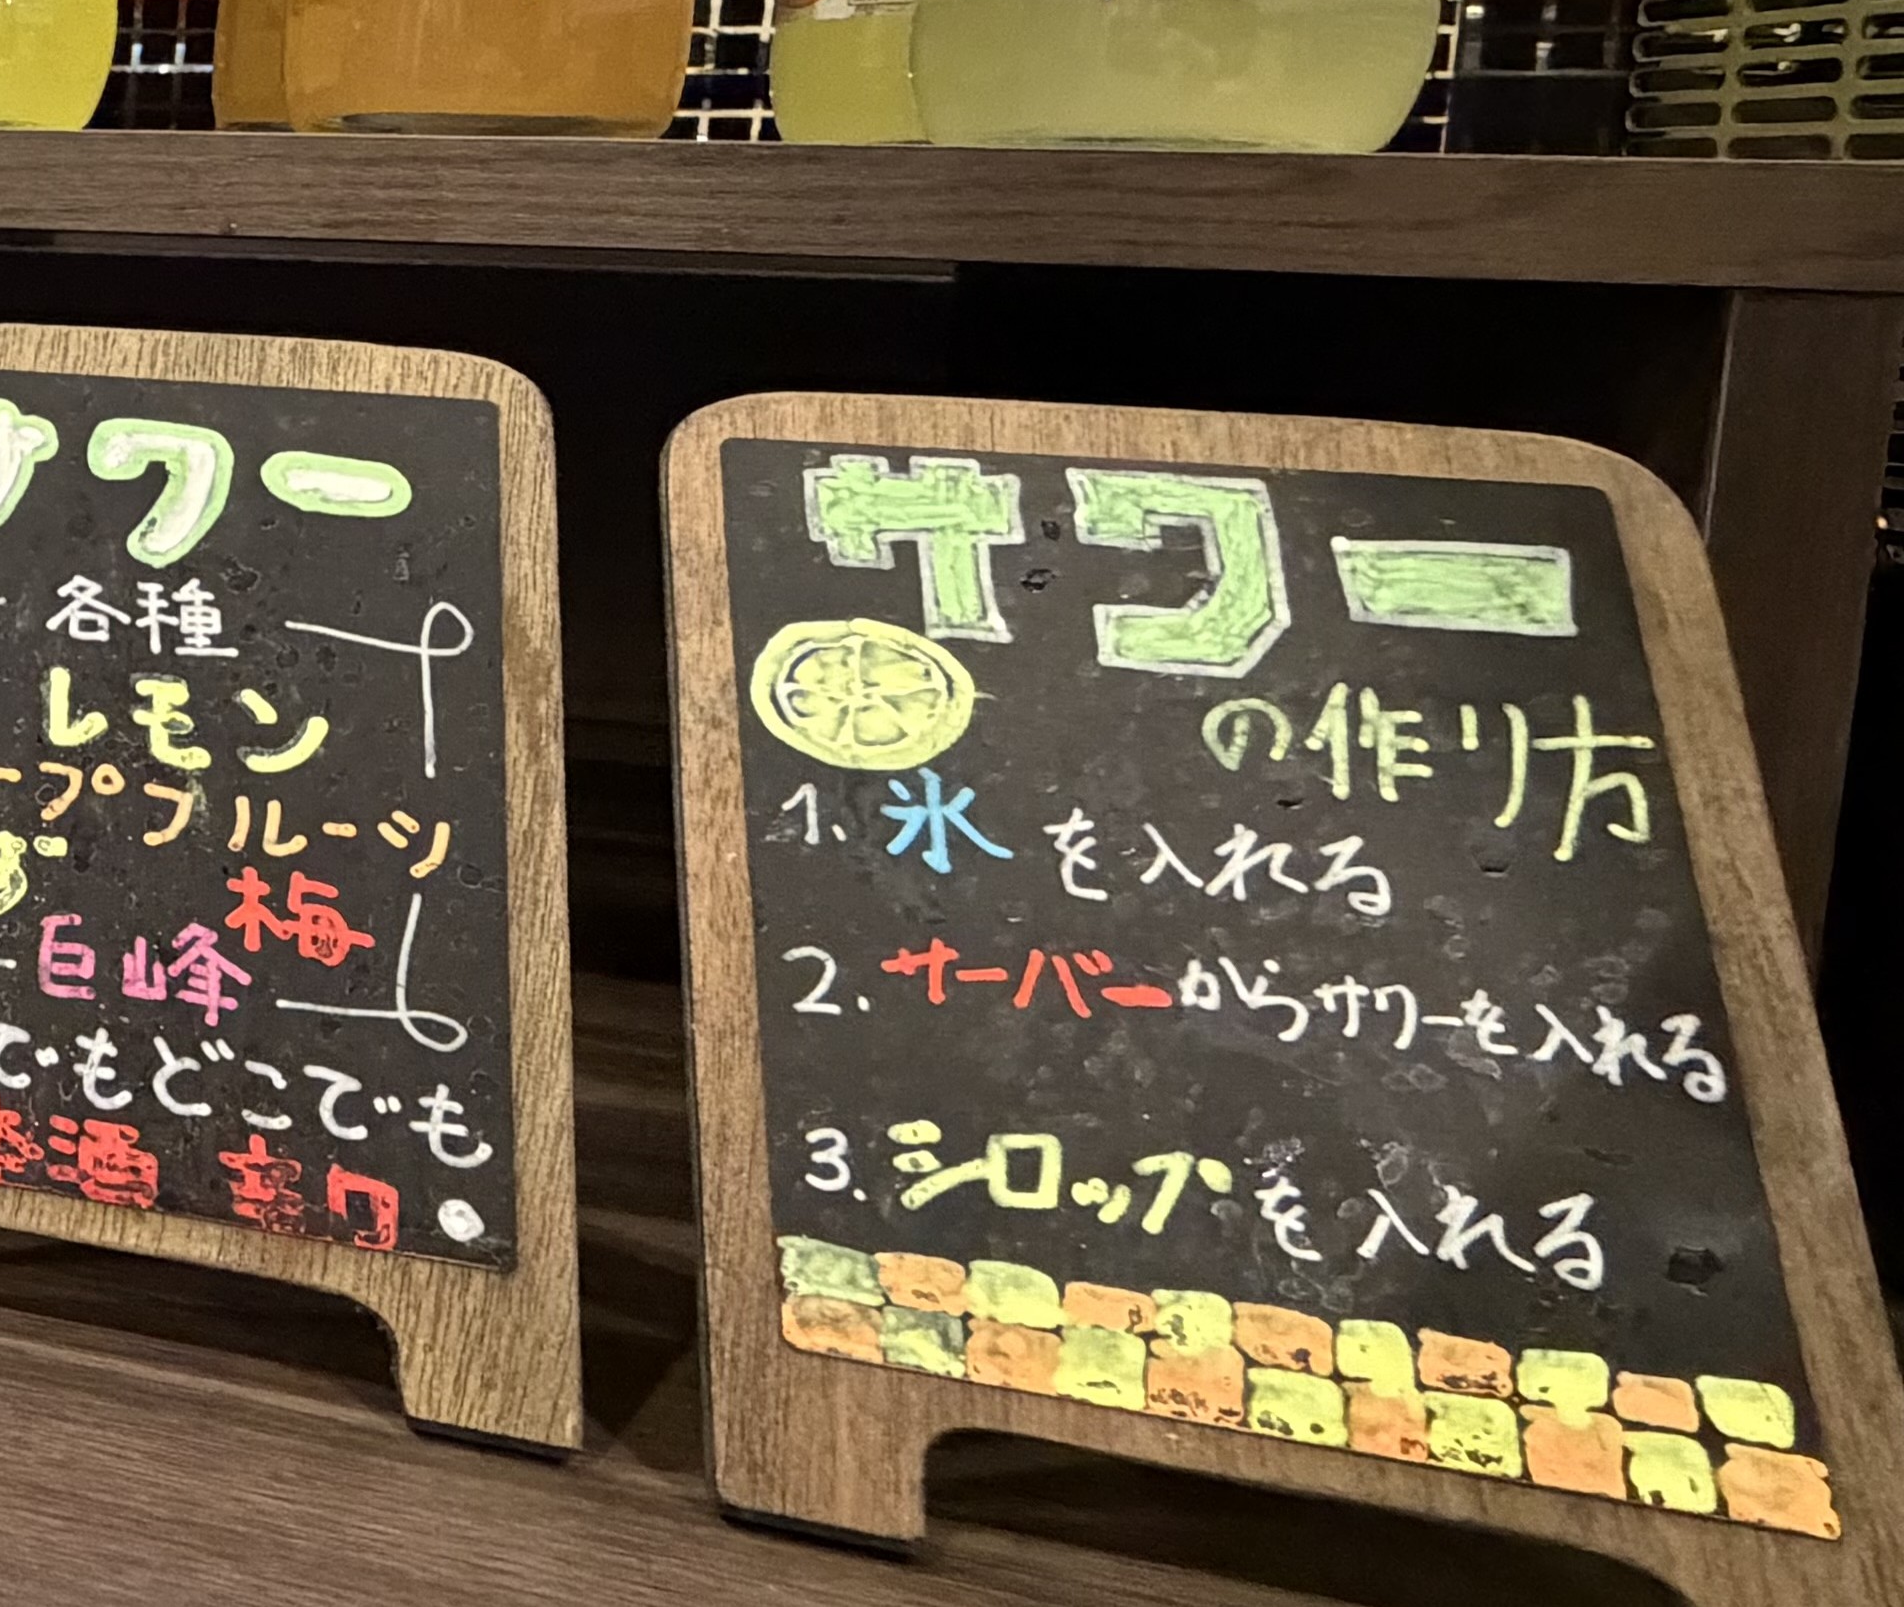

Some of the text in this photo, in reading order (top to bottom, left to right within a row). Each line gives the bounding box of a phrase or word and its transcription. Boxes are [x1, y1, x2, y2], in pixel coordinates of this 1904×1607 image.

[45, 576, 240, 659] 各種
[803, 454, 1579, 678] サワー
[47, 667, 329, 773] レモン
[1202, 682, 1659, 861] の作り方
[37, 914, 253, 1026] 巨峰
[225, 866, 375, 966] 梅
